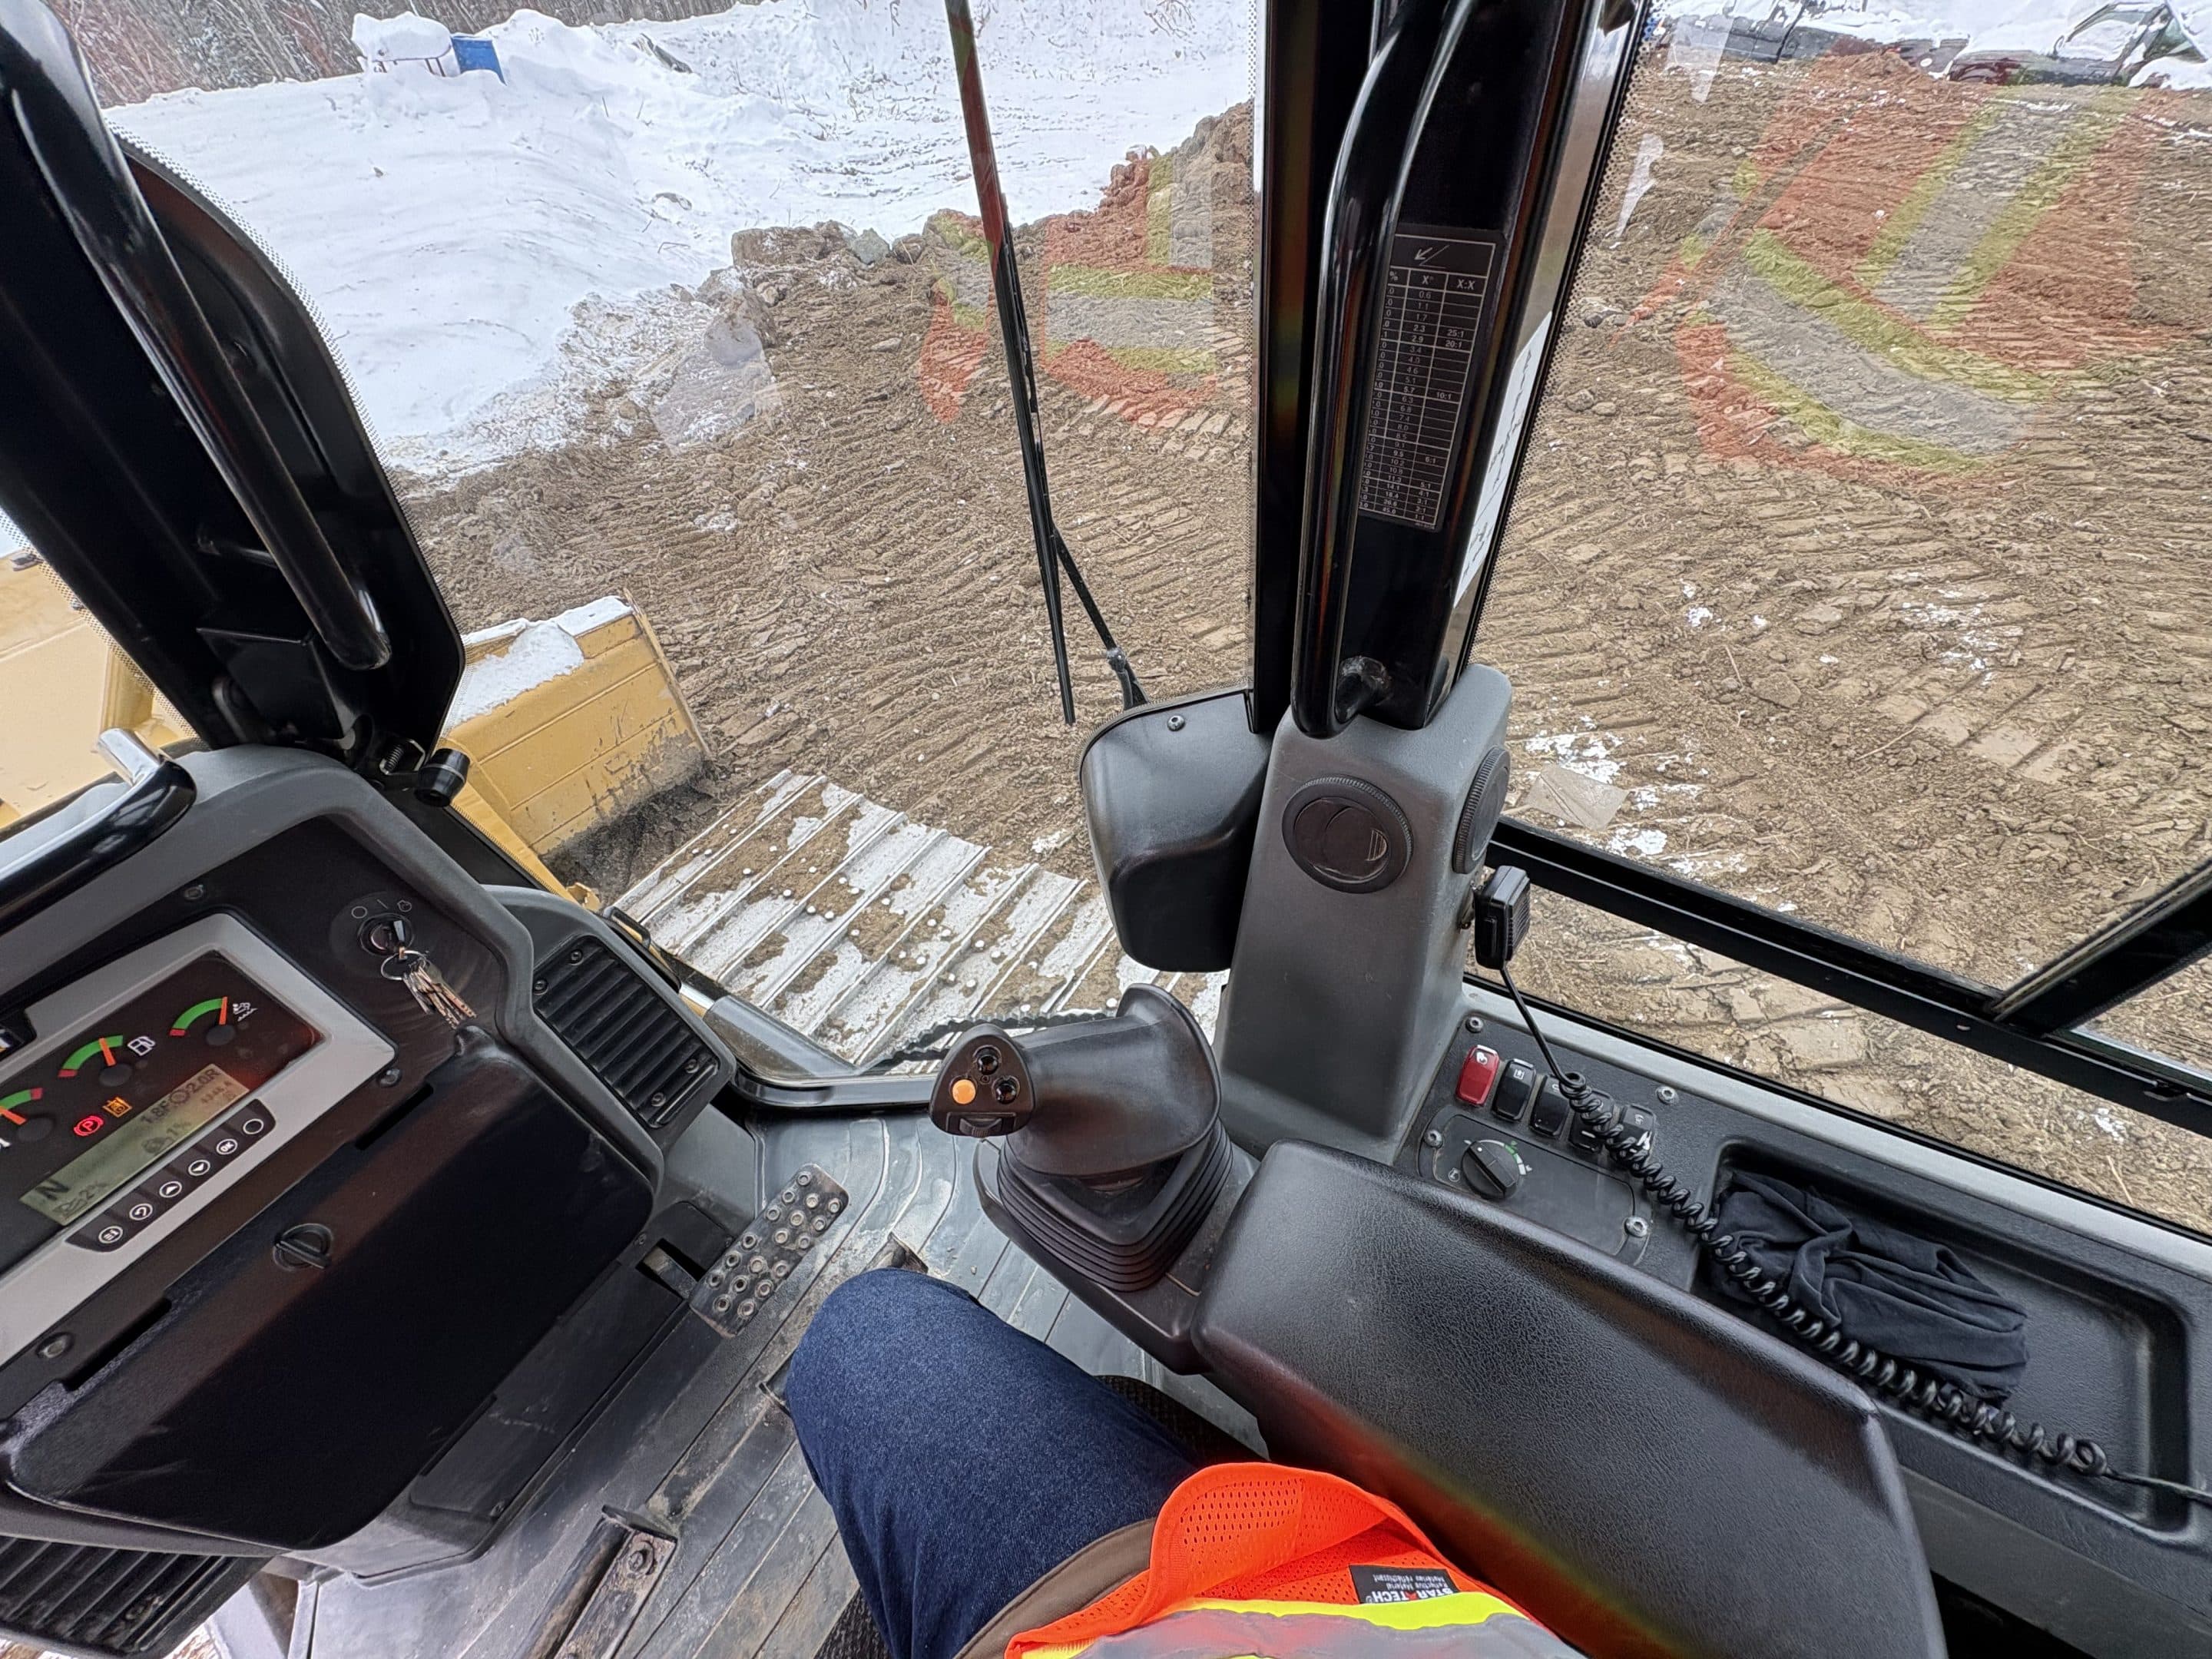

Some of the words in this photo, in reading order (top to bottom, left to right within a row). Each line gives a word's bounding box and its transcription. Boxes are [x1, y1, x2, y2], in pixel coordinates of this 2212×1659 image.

[1457, 278, 1475, 290] X:X
[1416, 302, 1430, 310] 1.1
[1447, 329, 1465, 337] 25:1
[1412, 334, 1424, 343] 2.9
[1445, 339, 1462, 348] 20:1
[1409, 345, 1422, 353] 3.4
[1406, 366, 1419, 374] 4.6
[1402, 395, 1414, 403] 6.3
[1435, 391, 1452, 399] 10:1
[220, 1141, 235, 1153] OK
[37, 1179, 69, 1200] N
